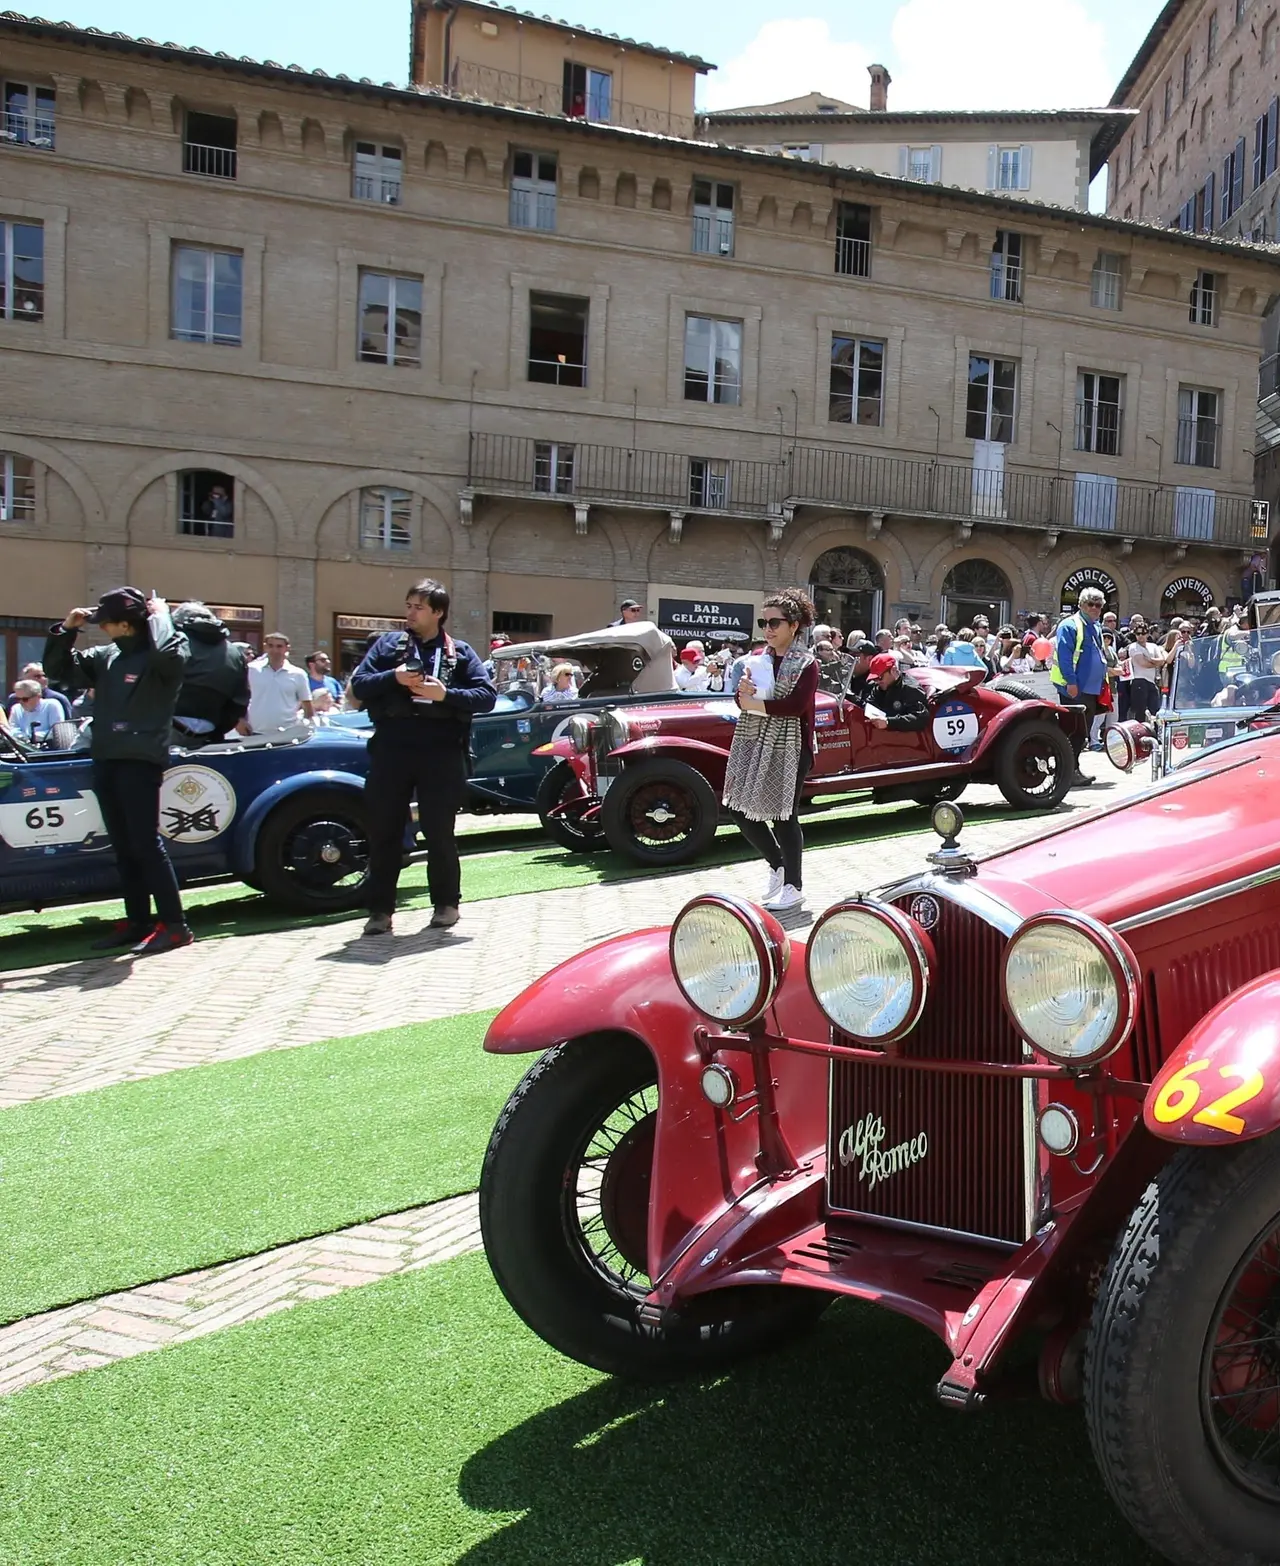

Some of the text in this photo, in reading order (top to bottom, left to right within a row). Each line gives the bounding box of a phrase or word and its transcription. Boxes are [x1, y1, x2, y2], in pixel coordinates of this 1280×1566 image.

[1064, 569, 1117, 594] TABACCHI
[1165, 578, 1214, 603] SOUVENIRS
[671, 613, 741, 626] GELATERIA
[693, 604, 720, 614] BAR
[339, 617, 385, 630] DOLCE
[946, 718, 965, 736] 59
[25, 806, 65, 829] 65
[1153, 1058, 1264, 1136] 62
[838, 1112, 886, 1182] Alfa
[865, 1131, 928, 1193] Romeo
